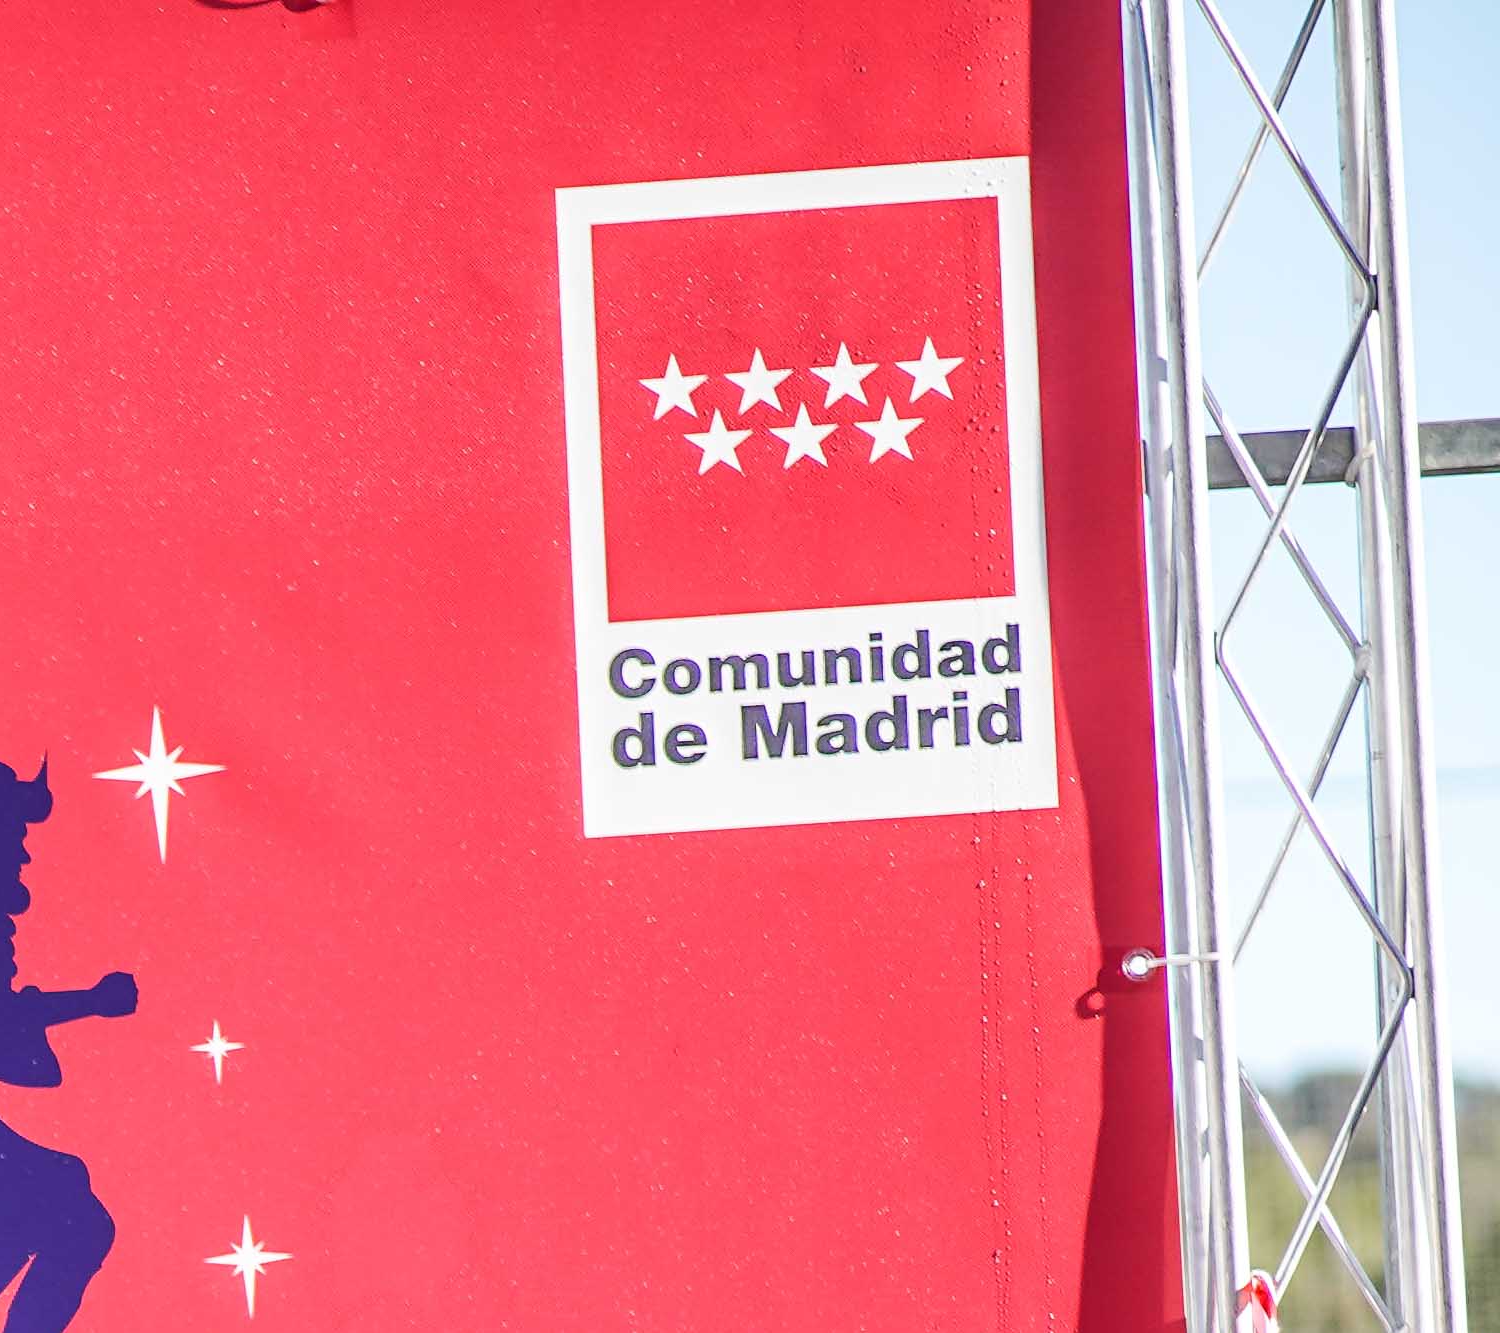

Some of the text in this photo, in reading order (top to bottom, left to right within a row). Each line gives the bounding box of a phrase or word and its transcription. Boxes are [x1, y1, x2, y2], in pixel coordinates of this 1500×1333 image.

[609, 624, 1022, 698] Comunidad
[612, 687, 1025, 768] de Madrid
